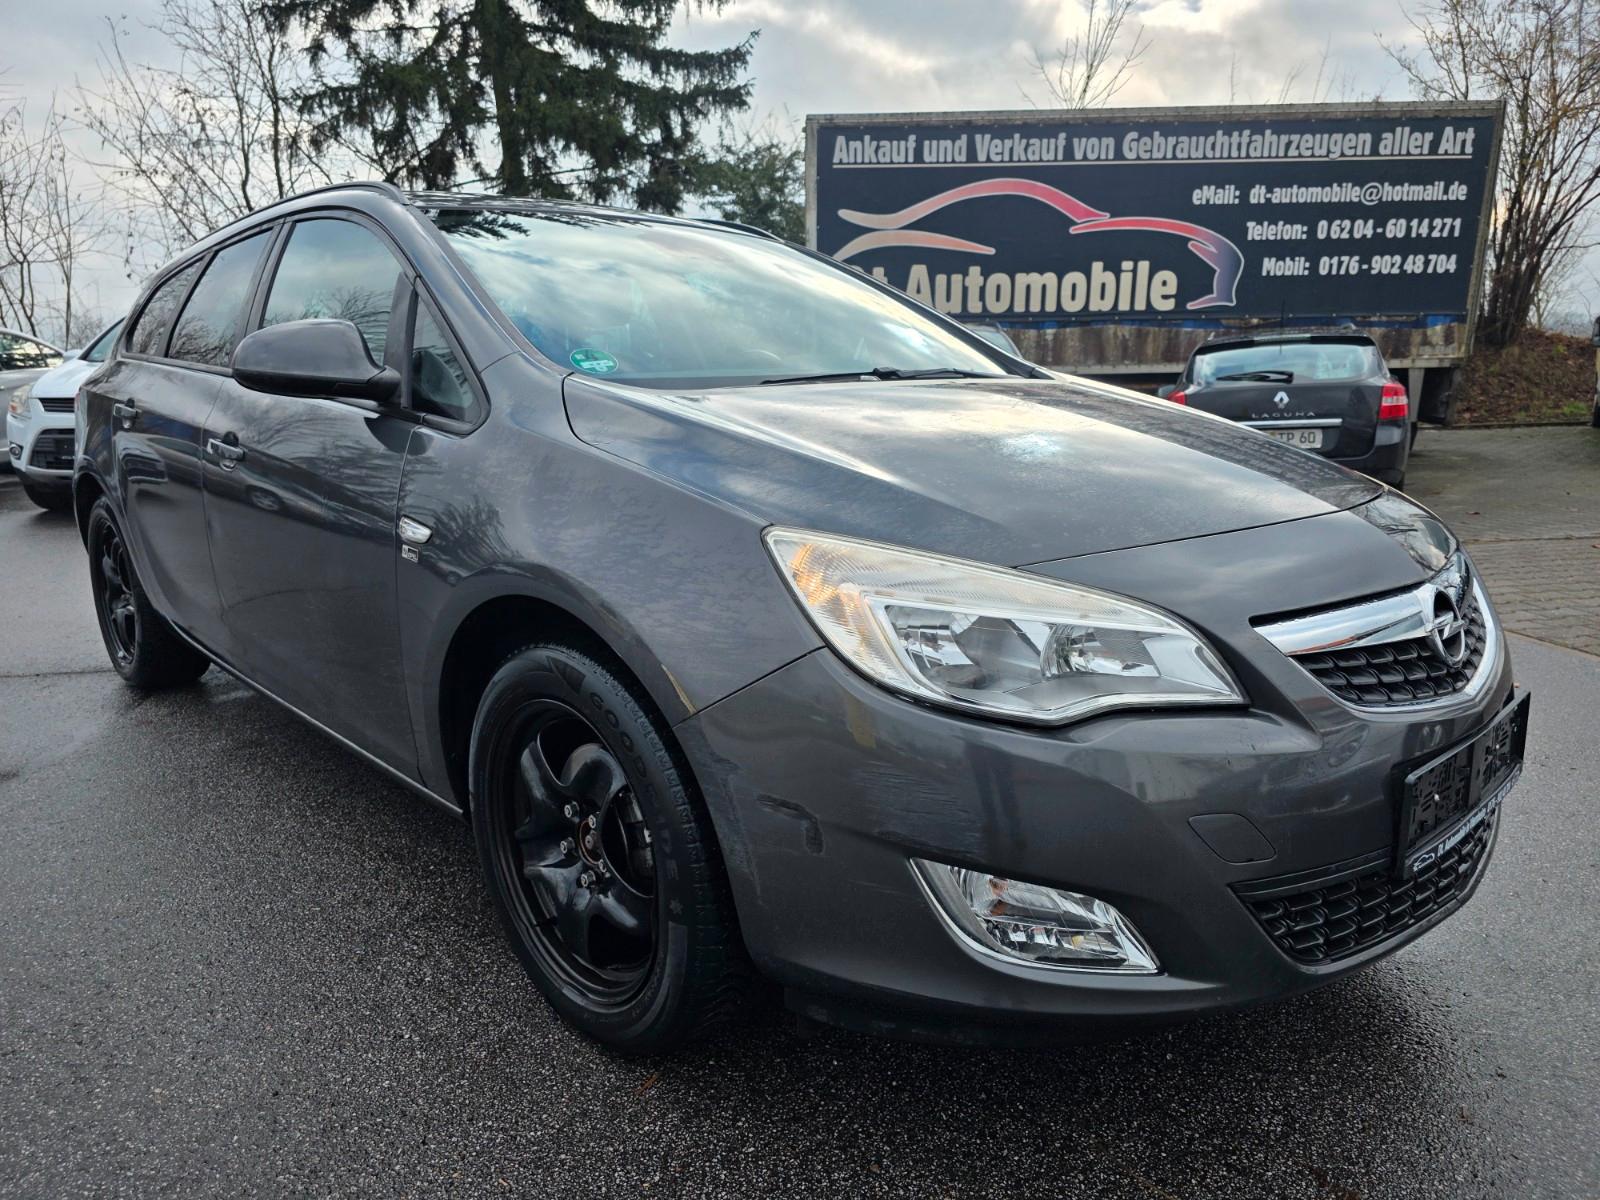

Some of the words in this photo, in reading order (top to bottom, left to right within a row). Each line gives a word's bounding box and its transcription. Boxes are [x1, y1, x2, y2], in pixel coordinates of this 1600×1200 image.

[832, 134, 917, 164] Ankauf
[923, 134, 967, 164] und
[975, 132, 1067, 162] Verkauf
[1073, 137, 1115, 161] von
[1122, 129, 1373, 160] Gebrauchtfahrzeugen
[1378, 126, 1434, 156] aller
[1437, 126, 1476, 155] Art
[1192, 184, 1240, 205] eMail:
[1249, 181, 1468, 206] dt-automobile@hotmail.de
[1246, 220, 1308, 241] Telefon:
[1261, 256, 1310, 277] Mobil:
[905, 259, 1178, 315] Automobile
[1299, 431, 1316, 444] 60
